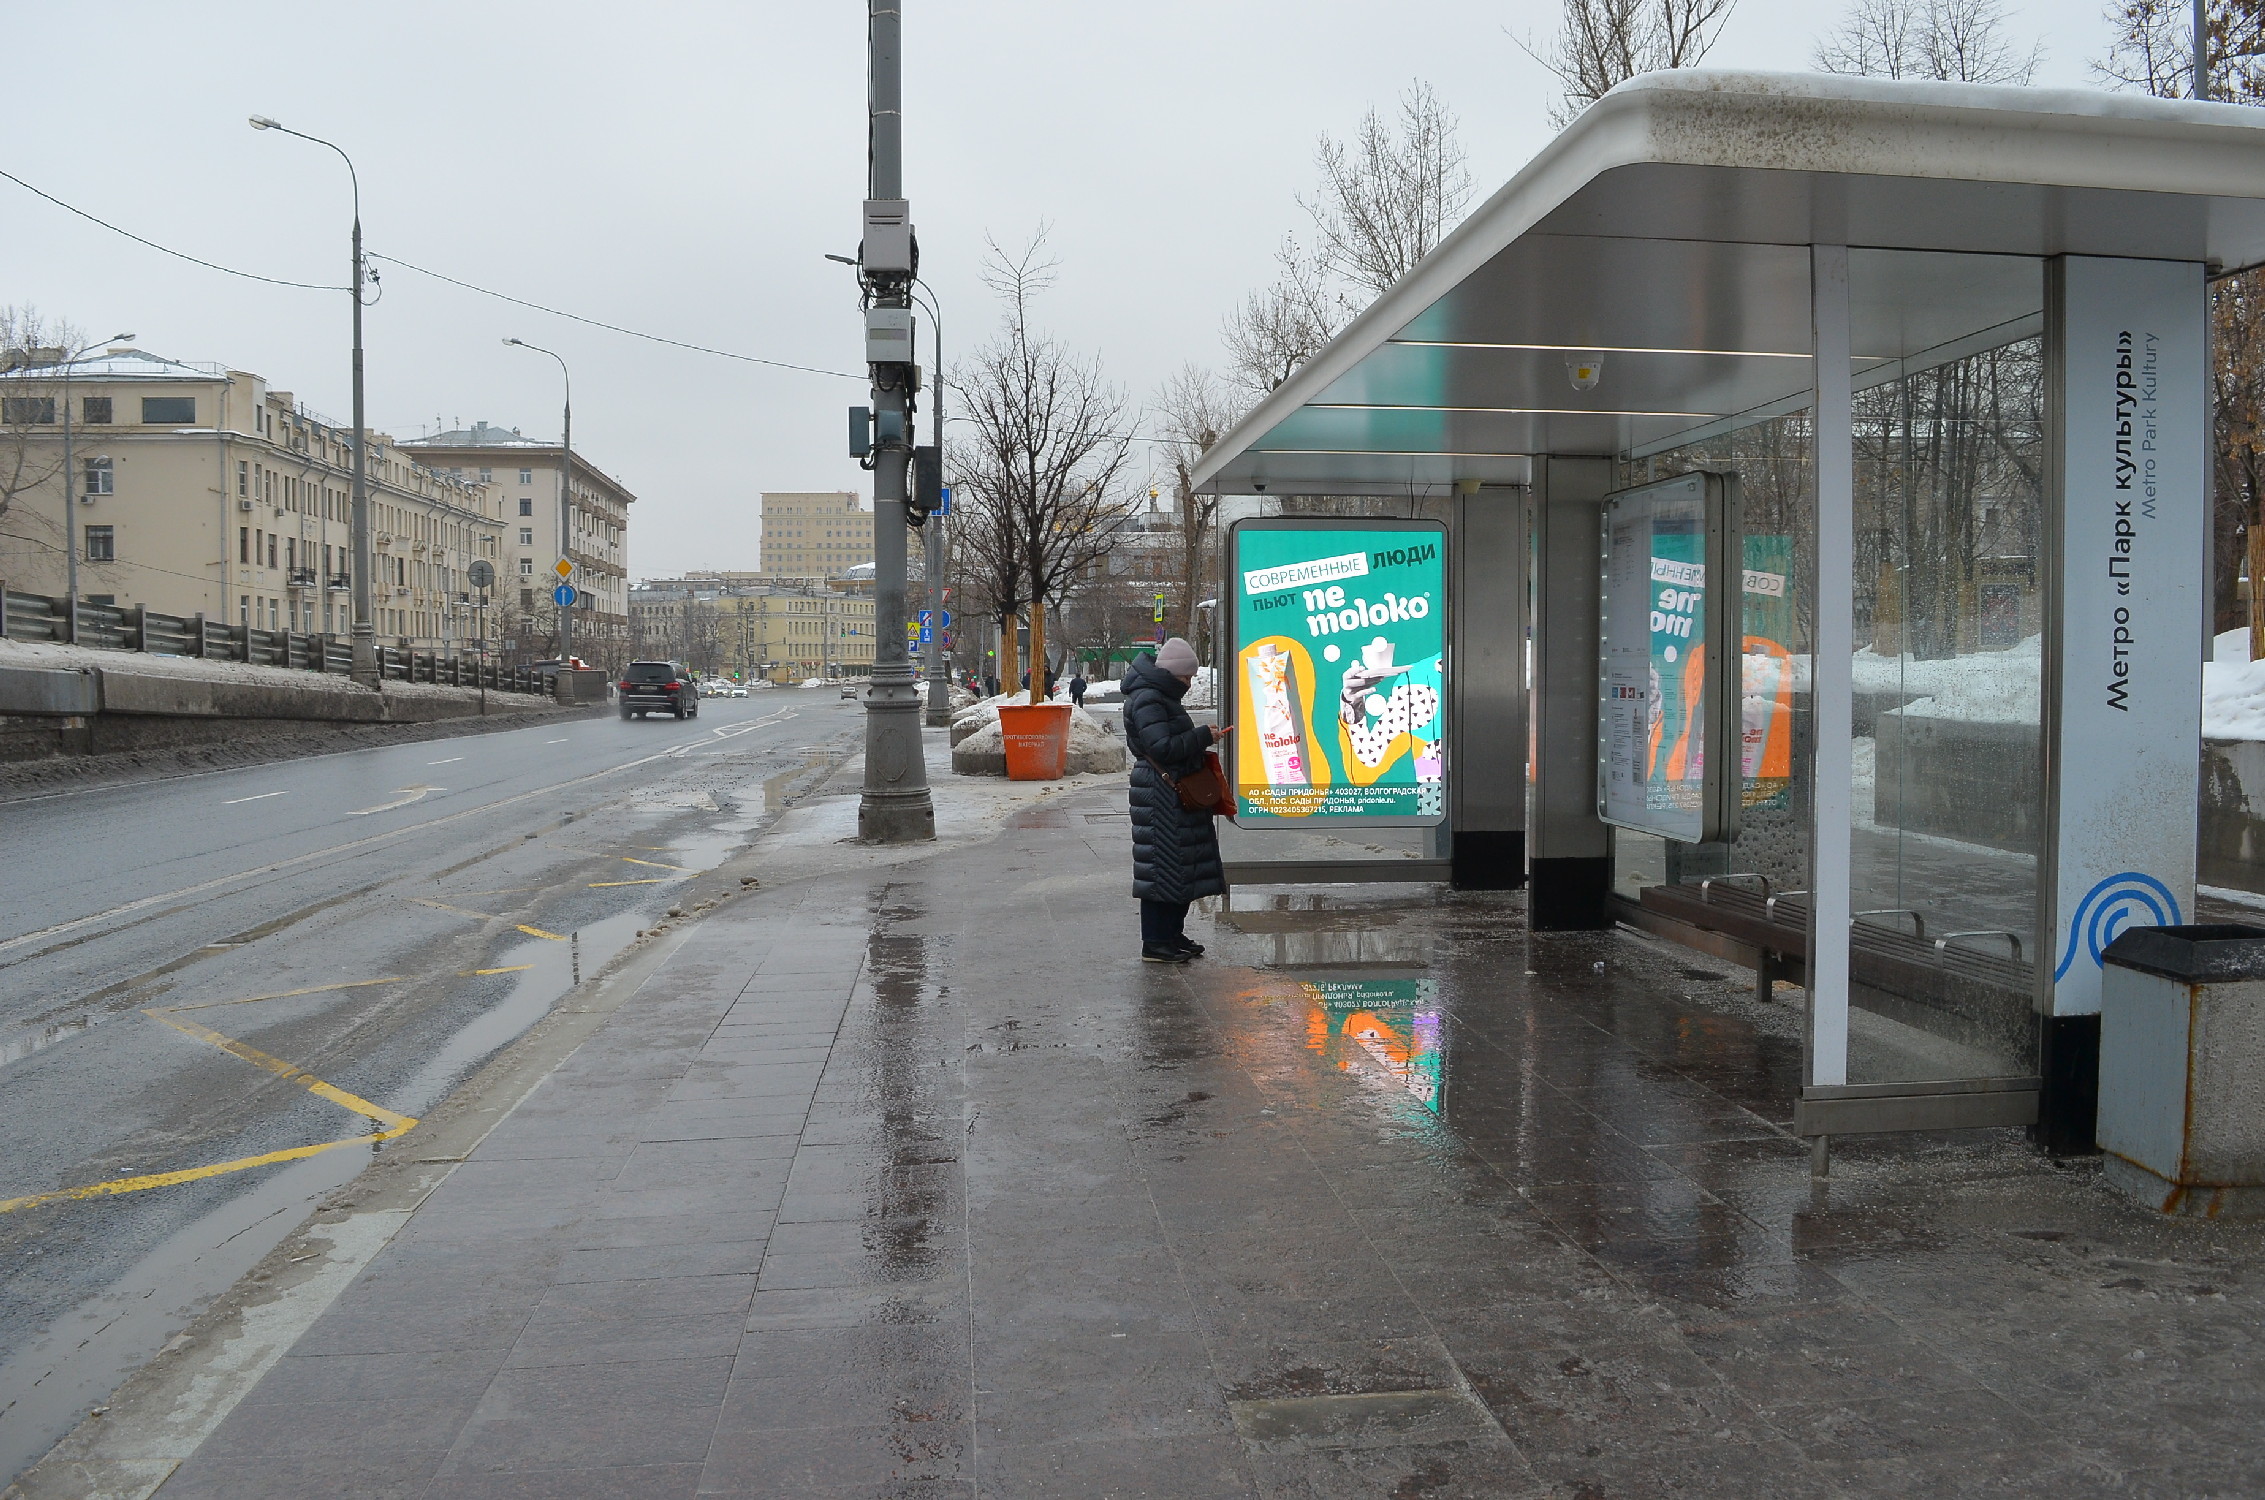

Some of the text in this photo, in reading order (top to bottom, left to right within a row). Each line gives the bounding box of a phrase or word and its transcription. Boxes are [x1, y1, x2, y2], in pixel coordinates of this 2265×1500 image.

[2141, 332, 2160, 519] Metro Park Kultury
[2106, 330, 2137, 712] Метро «Парк культуры»
[1249, 543, 1436, 589] СОВРЕМЕННЫЕ ЛЮДИ
[1252, 593, 1297, 612] ПЬЮТ
[1302, 585, 1346, 612] ne
[908, 640, 916, 651] P
[1364, 787, 1427, 796] ВОЛГОГРАДСКАЯ
[1248, 806, 1269, 814] ОГРН
[1329, 805, 1364, 813] РЕКЛАМА
[1289, 797, 1312, 806] САДЫ
